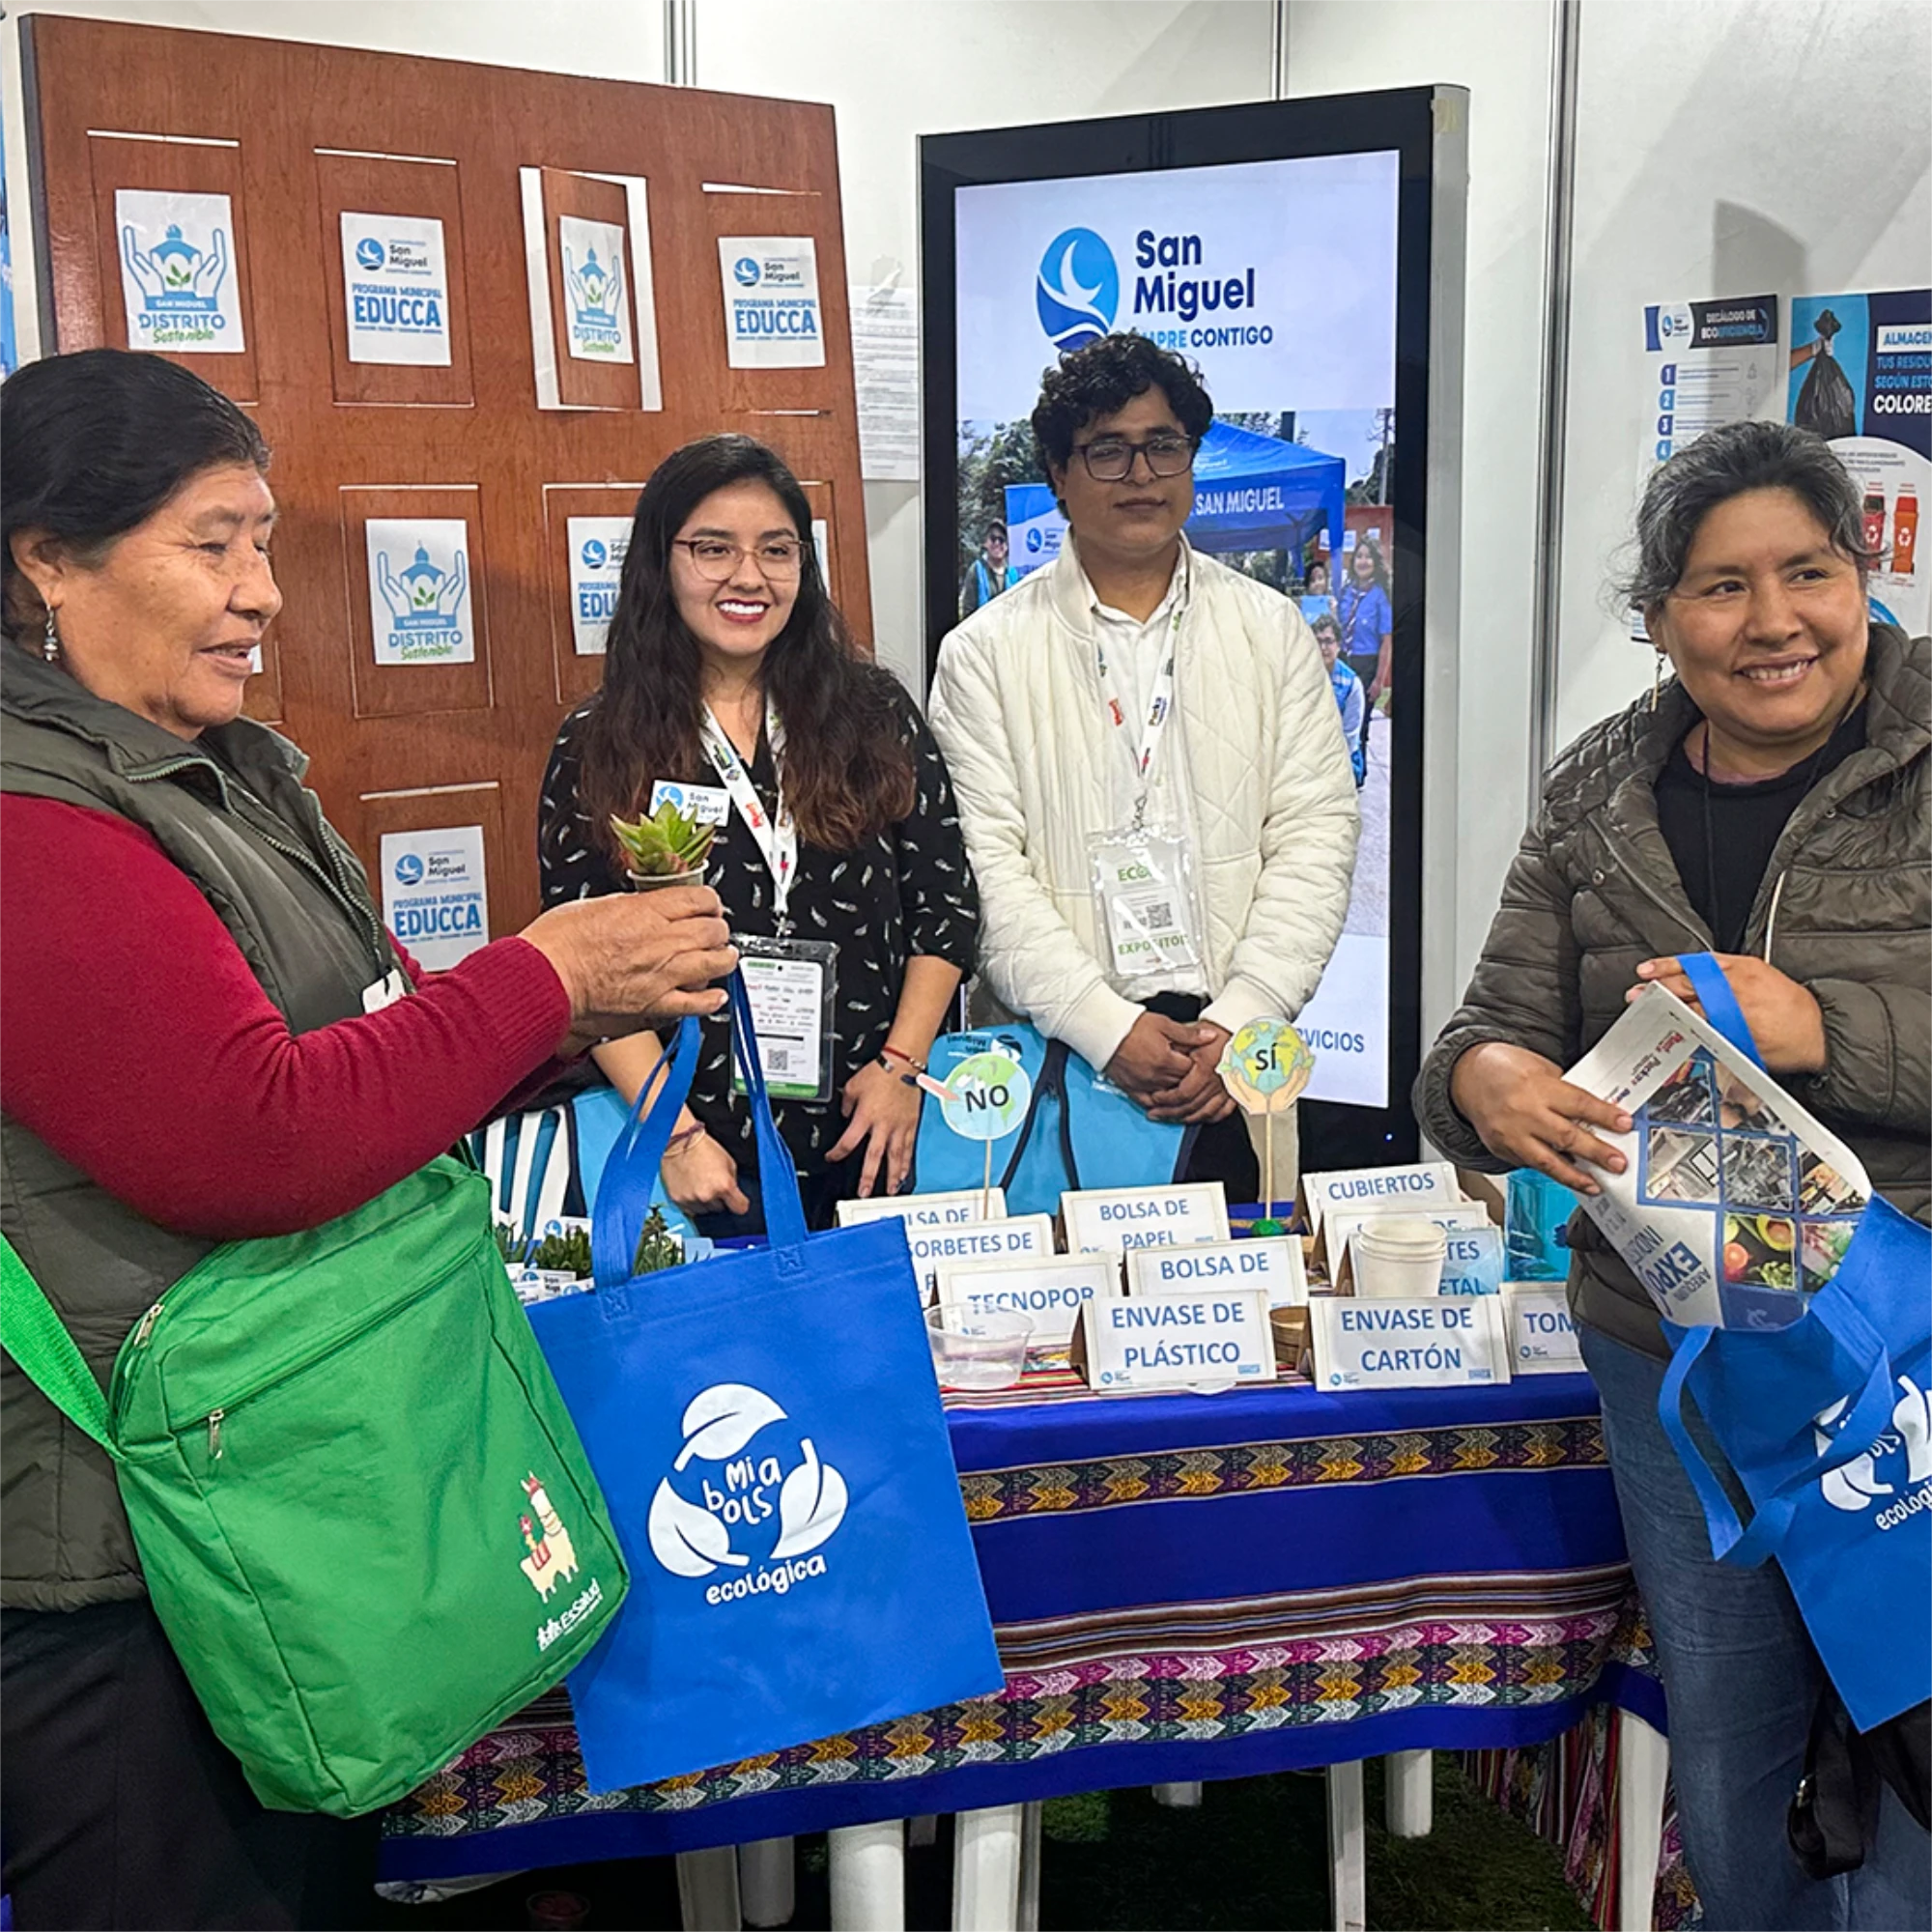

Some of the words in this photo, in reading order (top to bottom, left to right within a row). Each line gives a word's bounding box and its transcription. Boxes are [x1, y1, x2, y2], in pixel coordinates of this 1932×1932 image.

[1135, 230, 1203, 269] San
[389, 257, 428, 268] Miguel
[1133, 268, 1255, 322] Miguel
[138, 314, 226, 329] DISTRITO
[354, 295, 441, 327] EDUCCA
[735, 309, 817, 334] EDUCCA
[573, 325, 621, 344] DISTRITO
[1190, 326, 1273, 348] CONTIGO
[1877, 355, 1894, 369] TUS
[1665, 367, 1671, 383] 1
[1875, 371, 1910, 388] SEGÚN
[1663, 392, 1670, 407] 2
[1662, 417, 1669, 432] 3
[1196, 491, 1224, 515] SAN
[1225, 486, 1285, 514] MIGUEL
[580, 593, 615, 618] EDU
[388, 630, 463, 647] DISTRITO
[687, 802, 723, 814] Mguel
[394, 903, 481, 936] EDUCCA
[1255, 1040, 1276, 1070] SÍ
[965, 1085, 1009, 1113] NO
[1328, 1173, 1435, 1200] CUBIERTOS
[946, 1208, 969, 1223] DE
[1099, 1201, 1160, 1221] BOLSA
[1164, 1199, 1189, 1215] DE
[909, 1235, 1002, 1258] ORBETES
[1007, 1232, 1033, 1251] DE
[1122, 1231, 1179, 1248] PAPEL
[1160, 1256, 1235, 1281] BOLSA
[1239, 1252, 1269, 1273] DE
[967, 1286, 1094, 1315] TECNOPOR
[1112, 1304, 1207, 1329] ENVASE
[1213, 1302, 1245, 1324] DE
[1342, 1308, 1435, 1332] ENVASE
[1442, 1307, 1473, 1329] DE
[1124, 1339, 1240, 1369] PLÁSTICO
[1360, 1342, 1462, 1372] CARTÓN
[725, 1456, 755, 1492] Mi
[705, 1553, 827, 1605] ecológica
